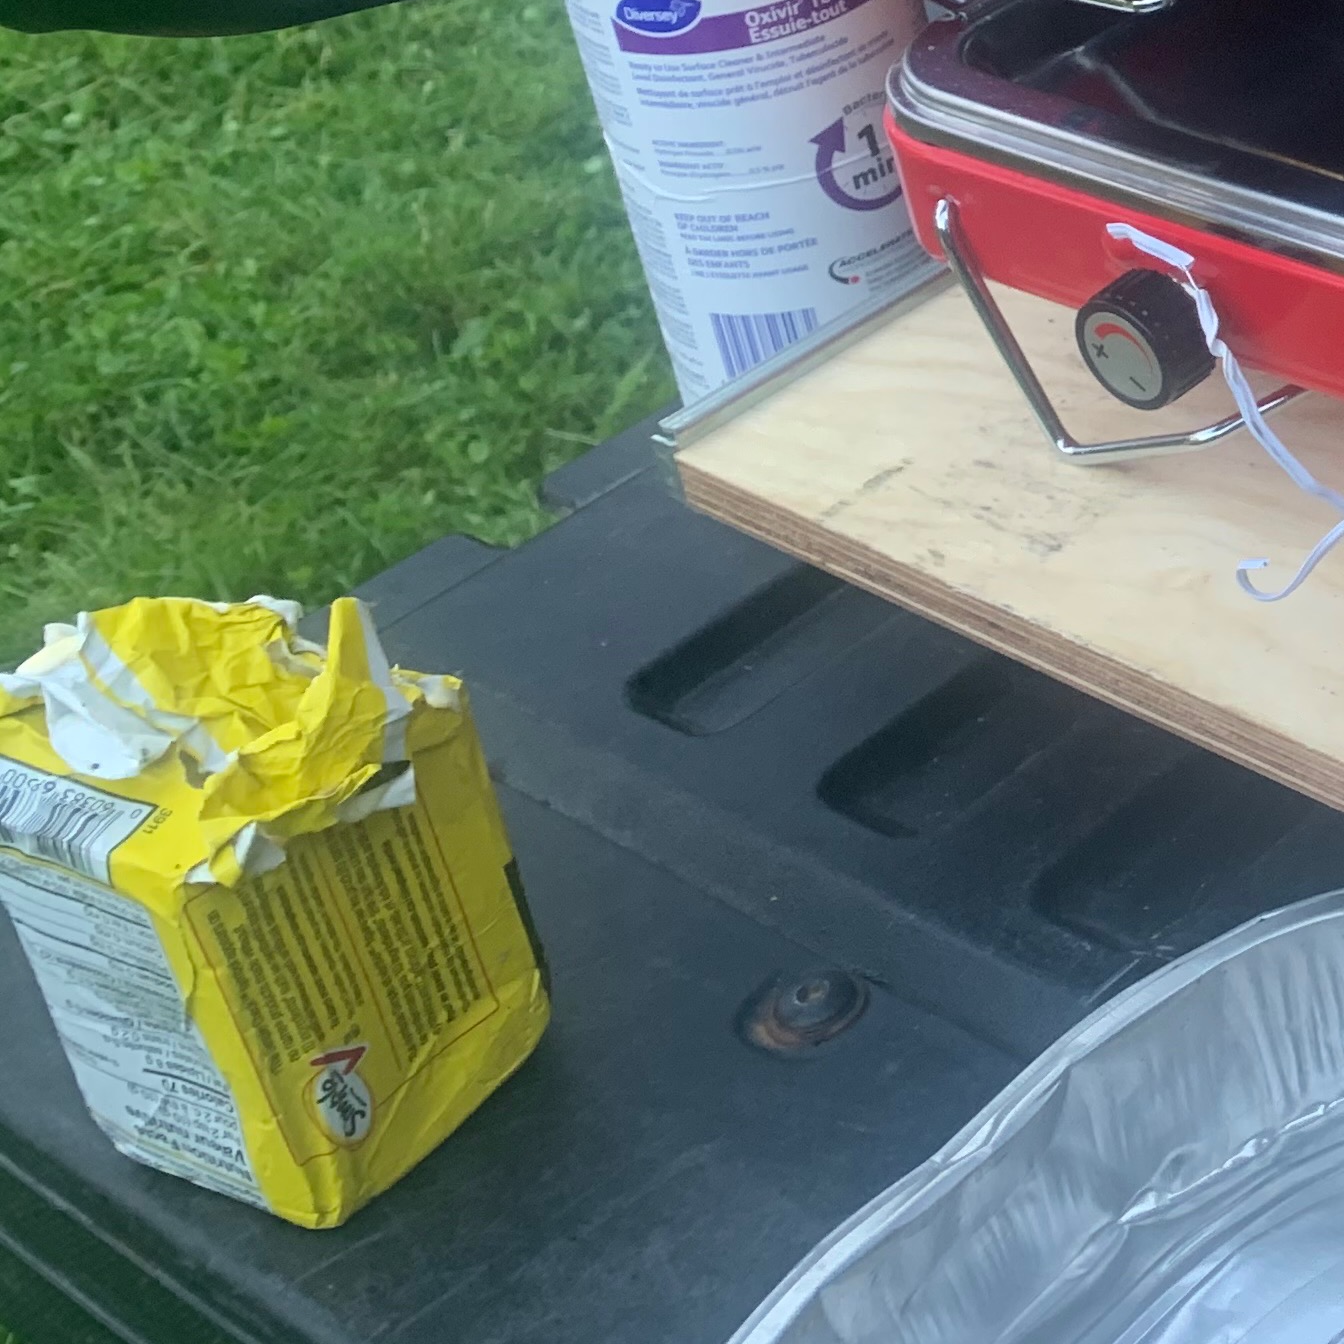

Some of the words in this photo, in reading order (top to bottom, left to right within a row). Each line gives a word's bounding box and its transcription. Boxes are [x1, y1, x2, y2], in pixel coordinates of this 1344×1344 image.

[623, 7, 678, 25] Diversey
[745, 0, 801, 28] Oxivir
[749, 0, 848, 43] Essuie-tout
[681, 61, 716, 73] Surface
[718, 57, 753, 69] Cleaner
[858, 123, 880, 157] 1
[181, 1084, 234, 1113] Calories
